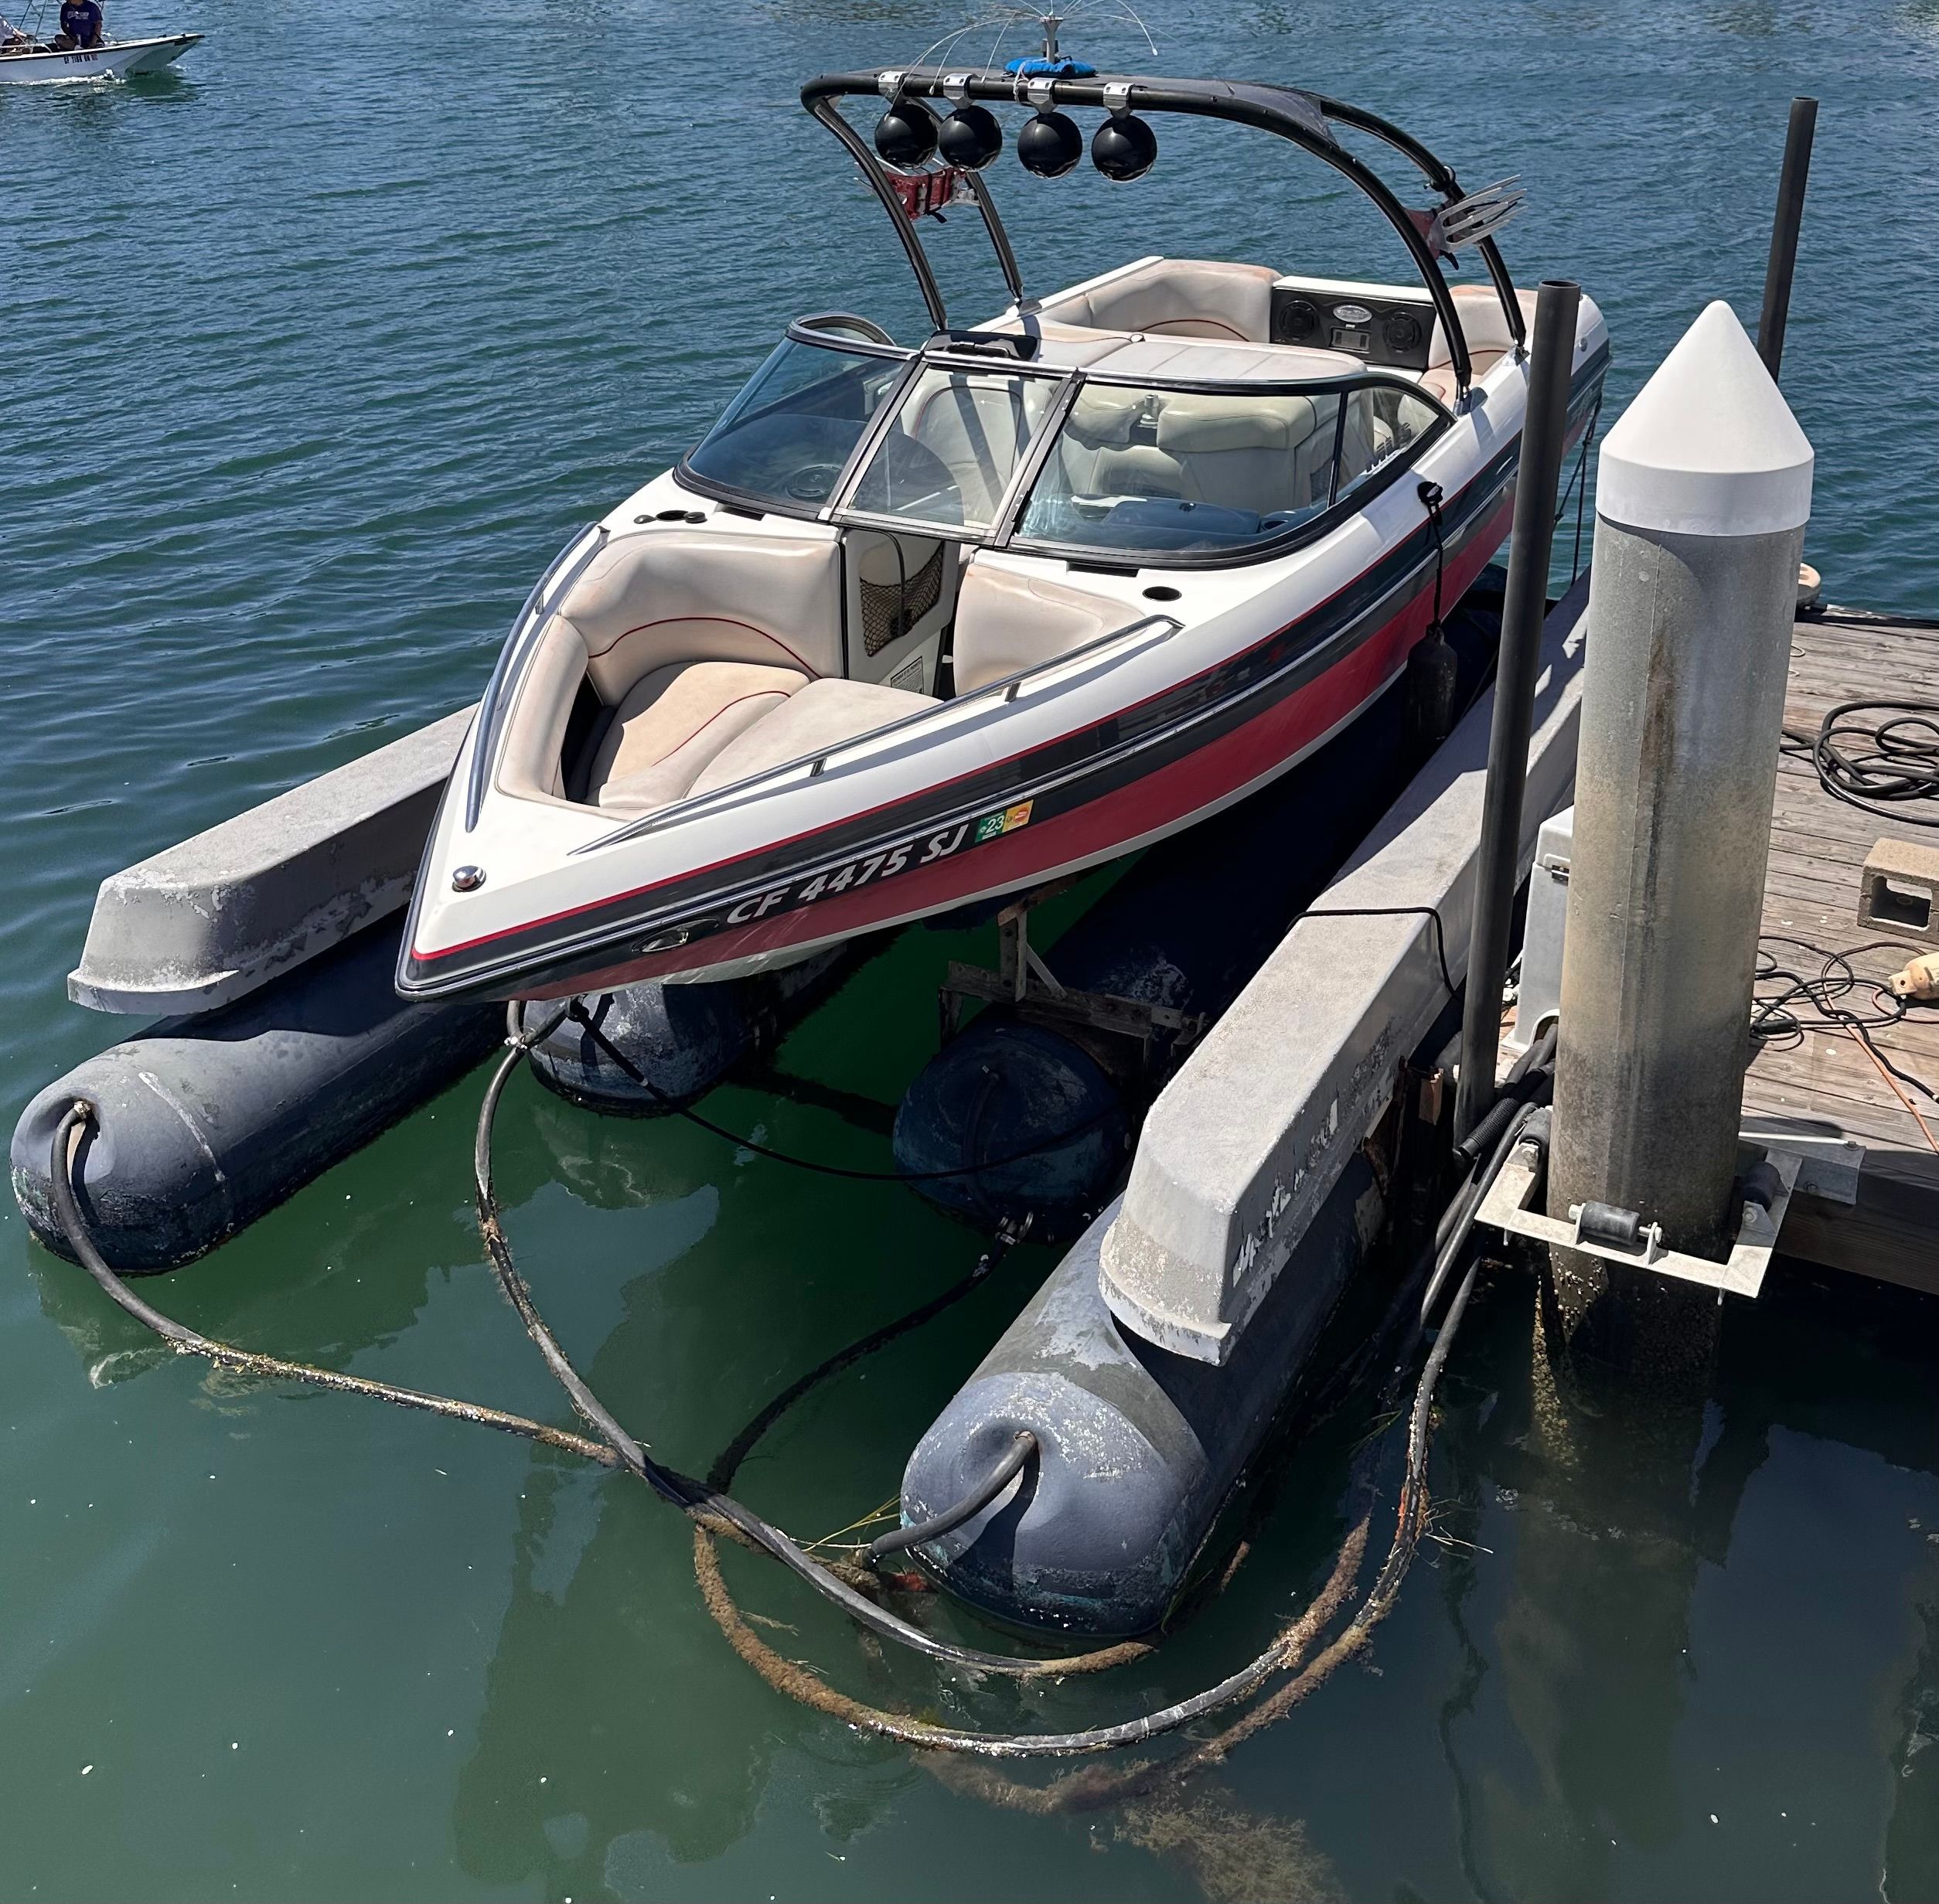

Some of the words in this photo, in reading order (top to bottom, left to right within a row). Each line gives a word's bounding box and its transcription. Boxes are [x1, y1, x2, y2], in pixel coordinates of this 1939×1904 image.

[985, 815, 1005, 834] 23
[727, 887, 790, 924] CF
[798, 844, 914, 901] 4475
[920, 824, 970, 863] SJ
